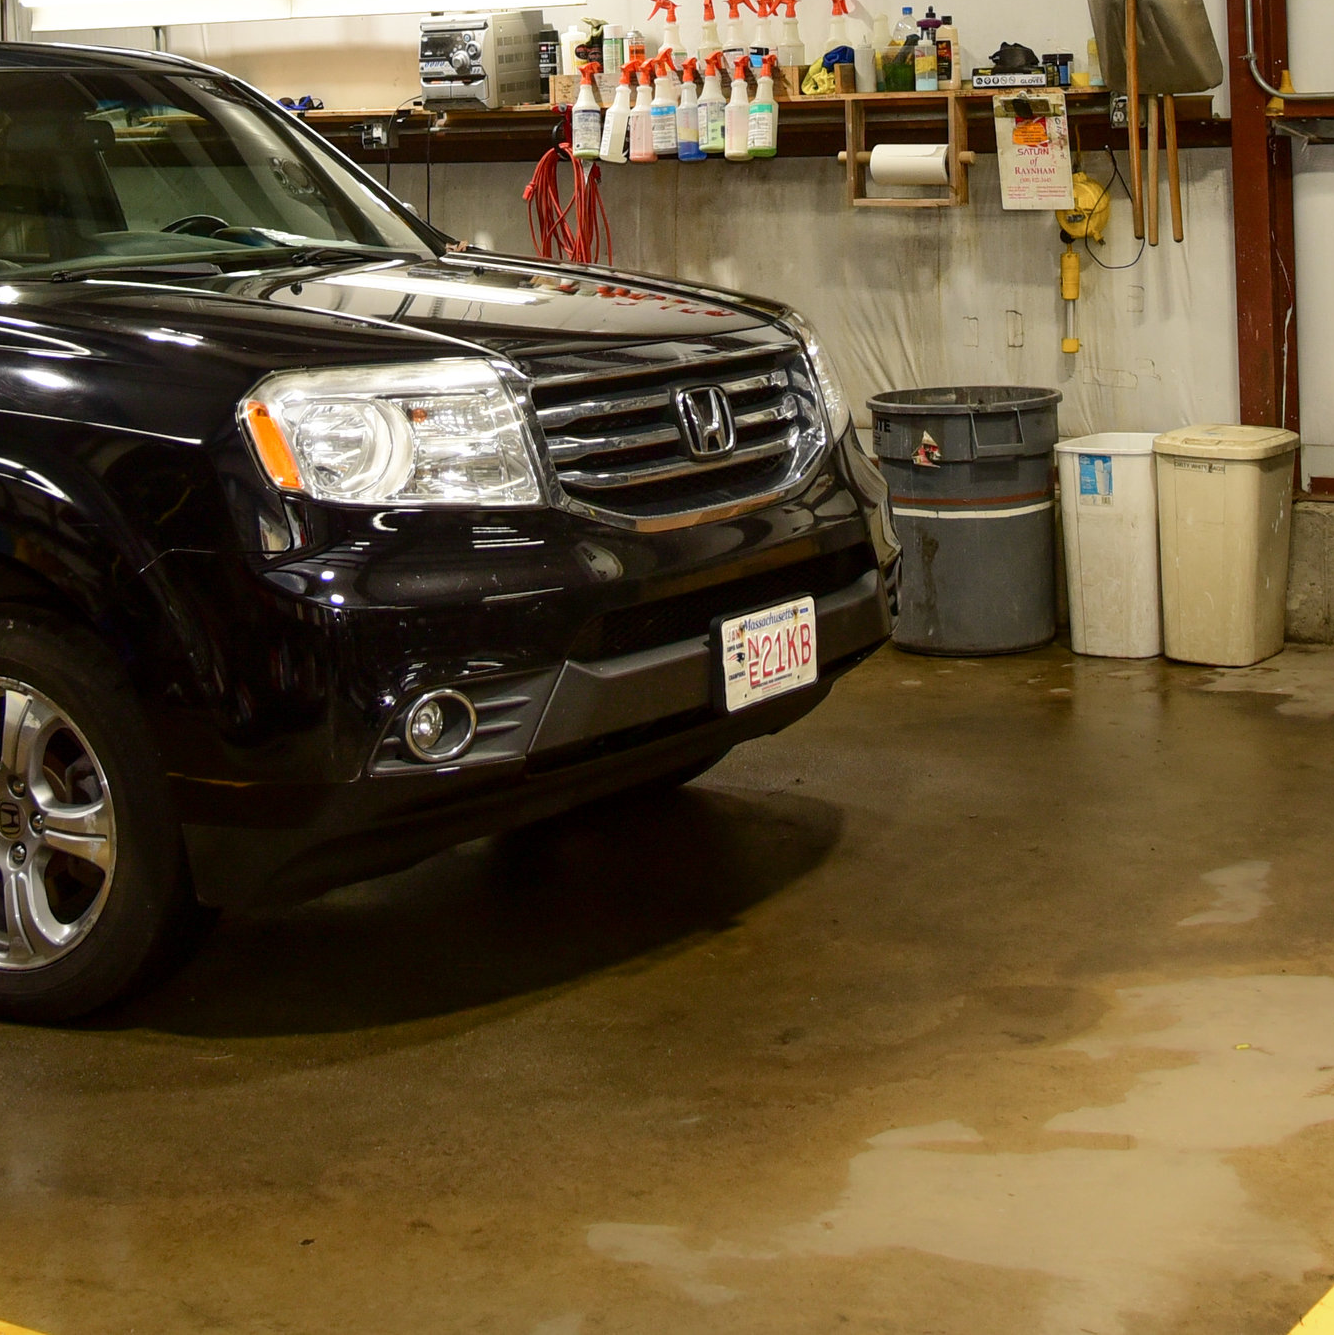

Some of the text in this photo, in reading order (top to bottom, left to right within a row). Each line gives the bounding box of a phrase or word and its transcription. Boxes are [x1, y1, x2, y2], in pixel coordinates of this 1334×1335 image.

[1020, 77, 1044, 85] GLOVES
[1014, 166, 1056, 175] RAYNHAM
[743, 610, 794, 632] Massachusetts
